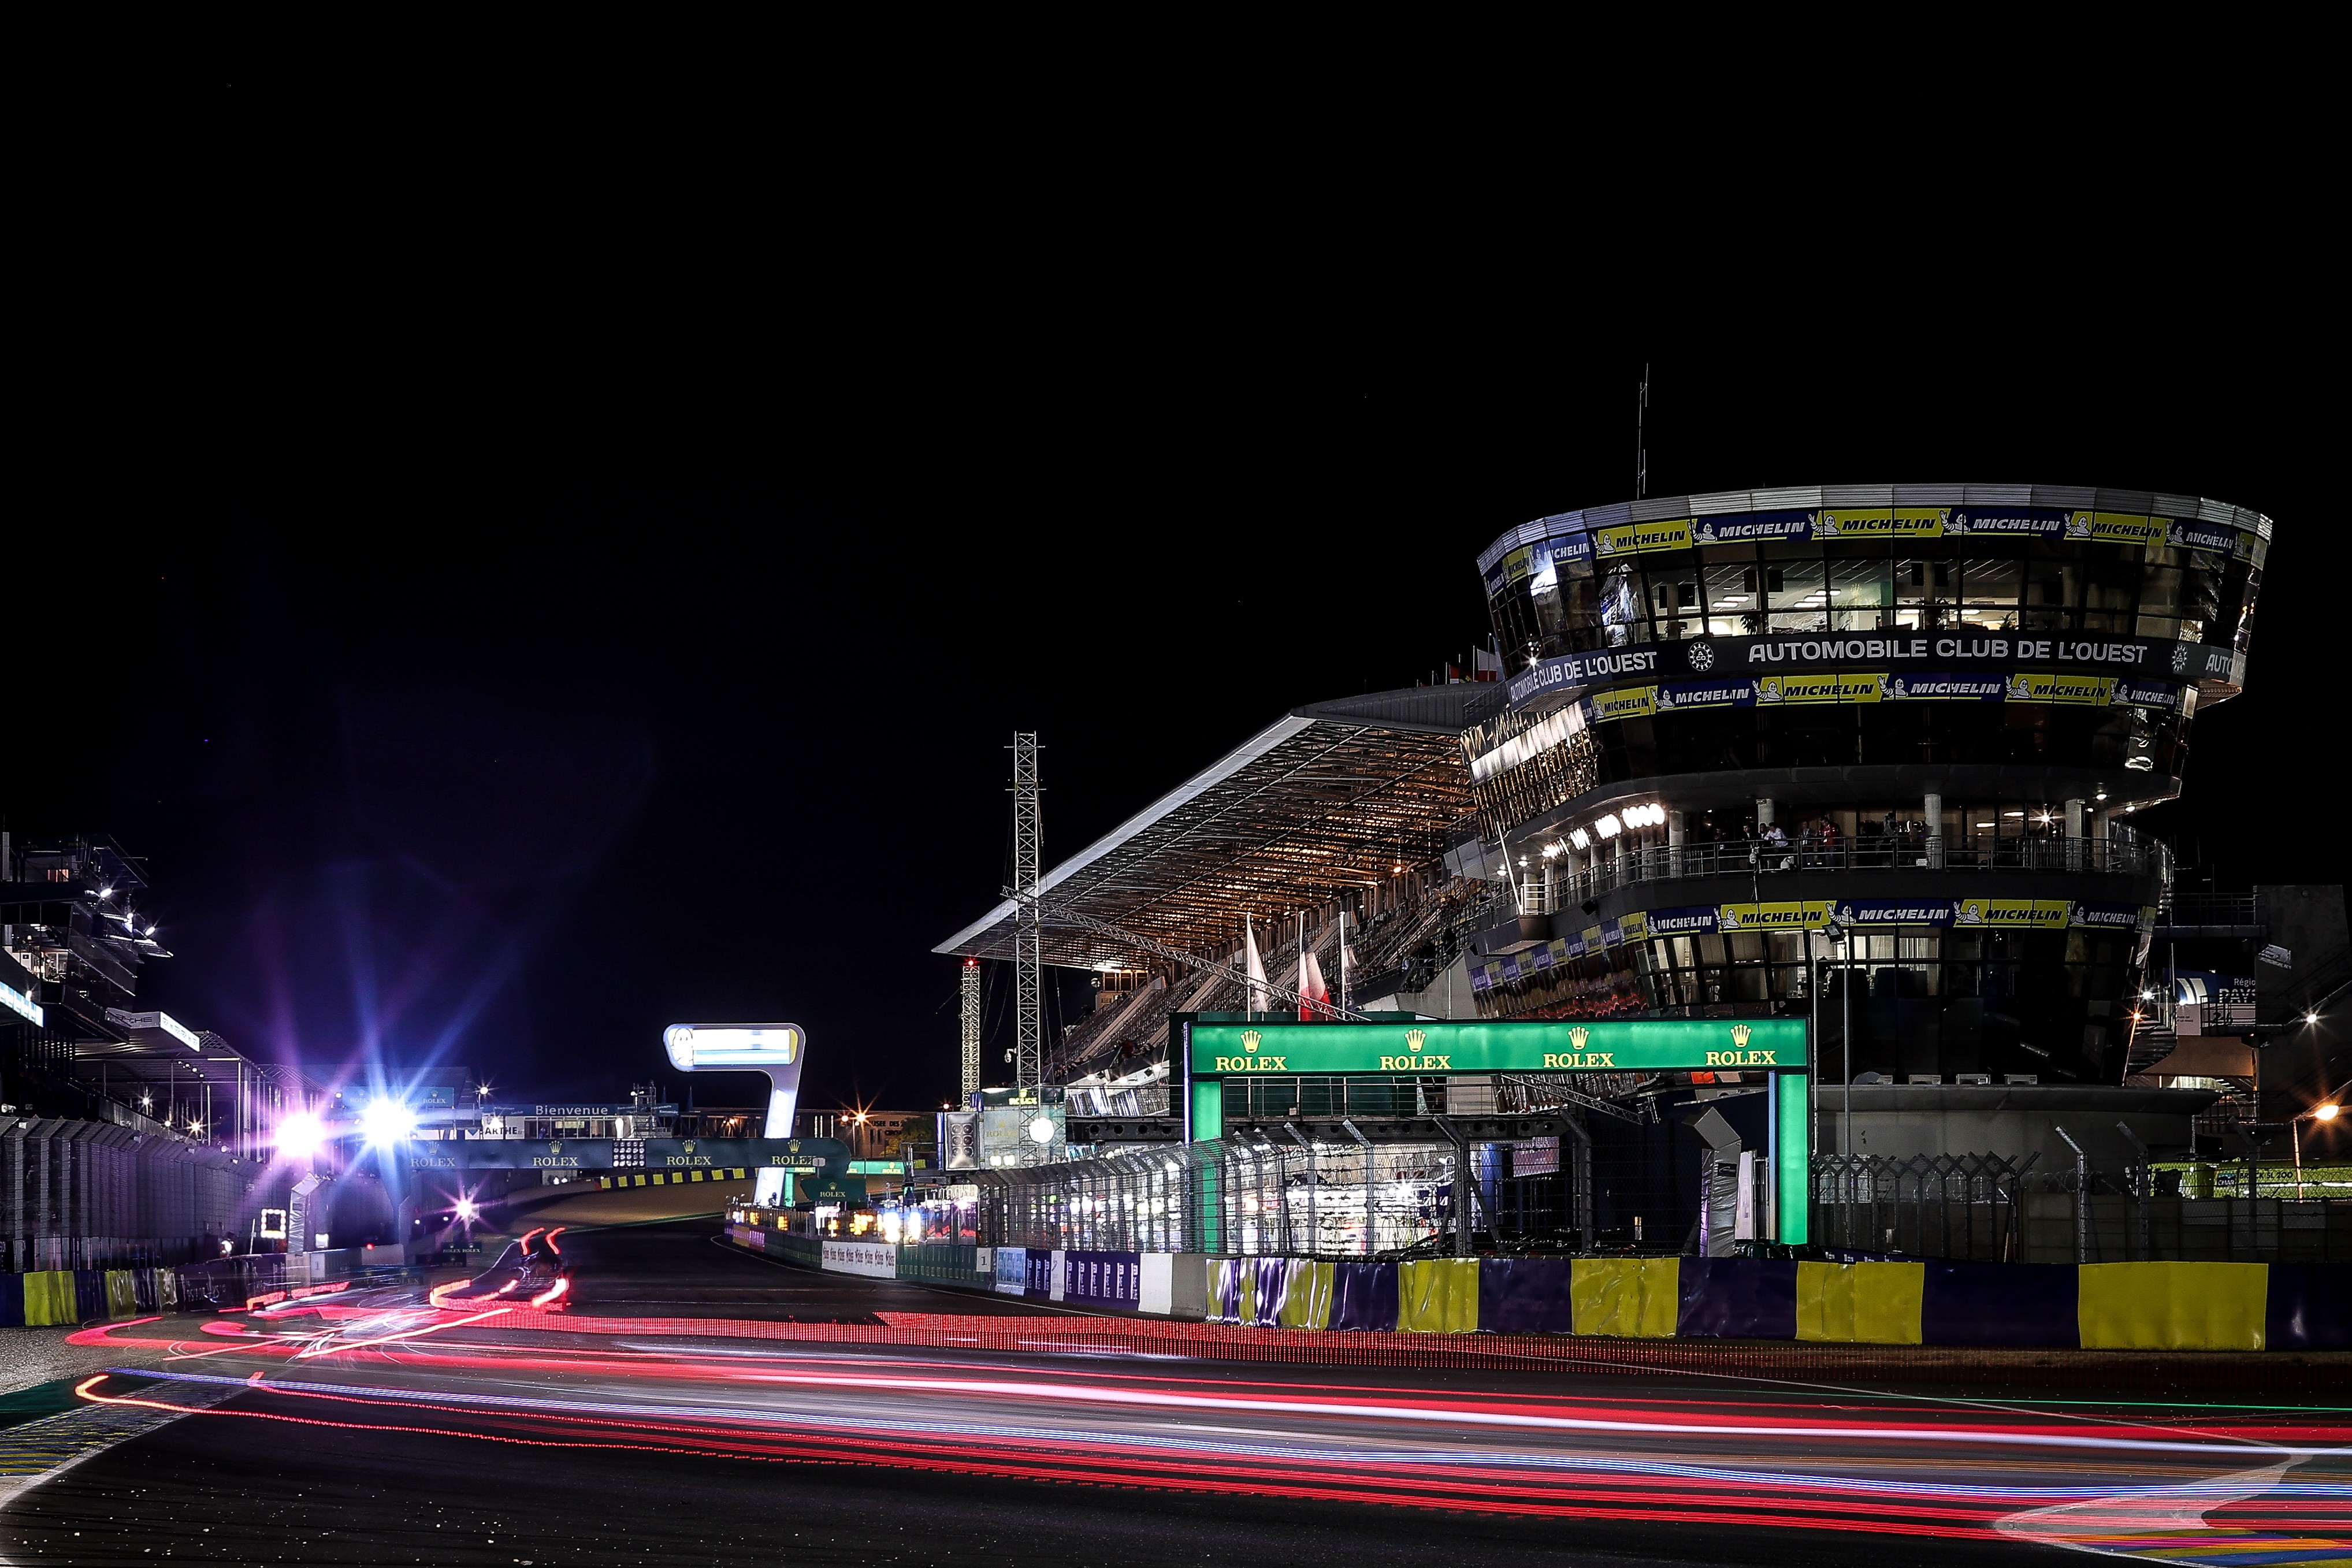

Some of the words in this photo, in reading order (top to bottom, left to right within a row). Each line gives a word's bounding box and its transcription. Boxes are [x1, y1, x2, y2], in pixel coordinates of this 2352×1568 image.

[1719, 522, 1805, 538] MICHELIN
[1842, 518, 1936, 531] MICHELIN
[1973, 518, 2060, 532] MICHELIN
[2093, 522, 2162, 538] MICHELIN
[1616, 530, 1685, 549] MICHELIN
[2186, 532, 2234, 549] MICHELIN
[1748, 640, 1927, 663] AUTOMOBILE
[1936, 640, 2009, 658] CLUB
[2017, 641, 2050, 659] DE
[2058, 642, 2147, 663] L'OUEST
[1539, 665, 1562, 686] CLUB
[1566, 660, 1583, 680] DE
[1585, 651, 1657, 677] L'OUEST
[1675, 688, 1749, 703] MICHELIN
[1784, 684, 1874, 697] MICHELIN
[1910, 683, 2001, 694] MICHELIN
[2033, 685, 2107, 699] MICHELIN
[1604, 697, 1649, 712] MICHELIN
[2130, 690, 2176, 705] MICHELIN
[1741, 909, 1823, 923] MICHELIN
[1858, 908, 1949, 920] MICHELIN
[1984, 908, 2063, 922] MICHELIN
[2087, 912, 2136, 924] MICHELIN
[1658, 916, 1712, 930] MICHELIN
[1215, 1056, 1288, 1071] ROLEX
[1379, 1056, 1451, 1071] ROLEX
[1543, 1053, 1615, 1068] ROLEX
[1705, 1050, 1777, 1066] ROLEX
[1009, 1097, 1038, 1105] ROLEX
[536, 1105, 608, 1116] Bienvenue
[411, 1157, 456, 1167] ROLEX
[533, 1157, 578, 1166] ROLEX
[666, 1155, 712, 1166] ROLEX
[980, 1255, 988, 1266] 1
